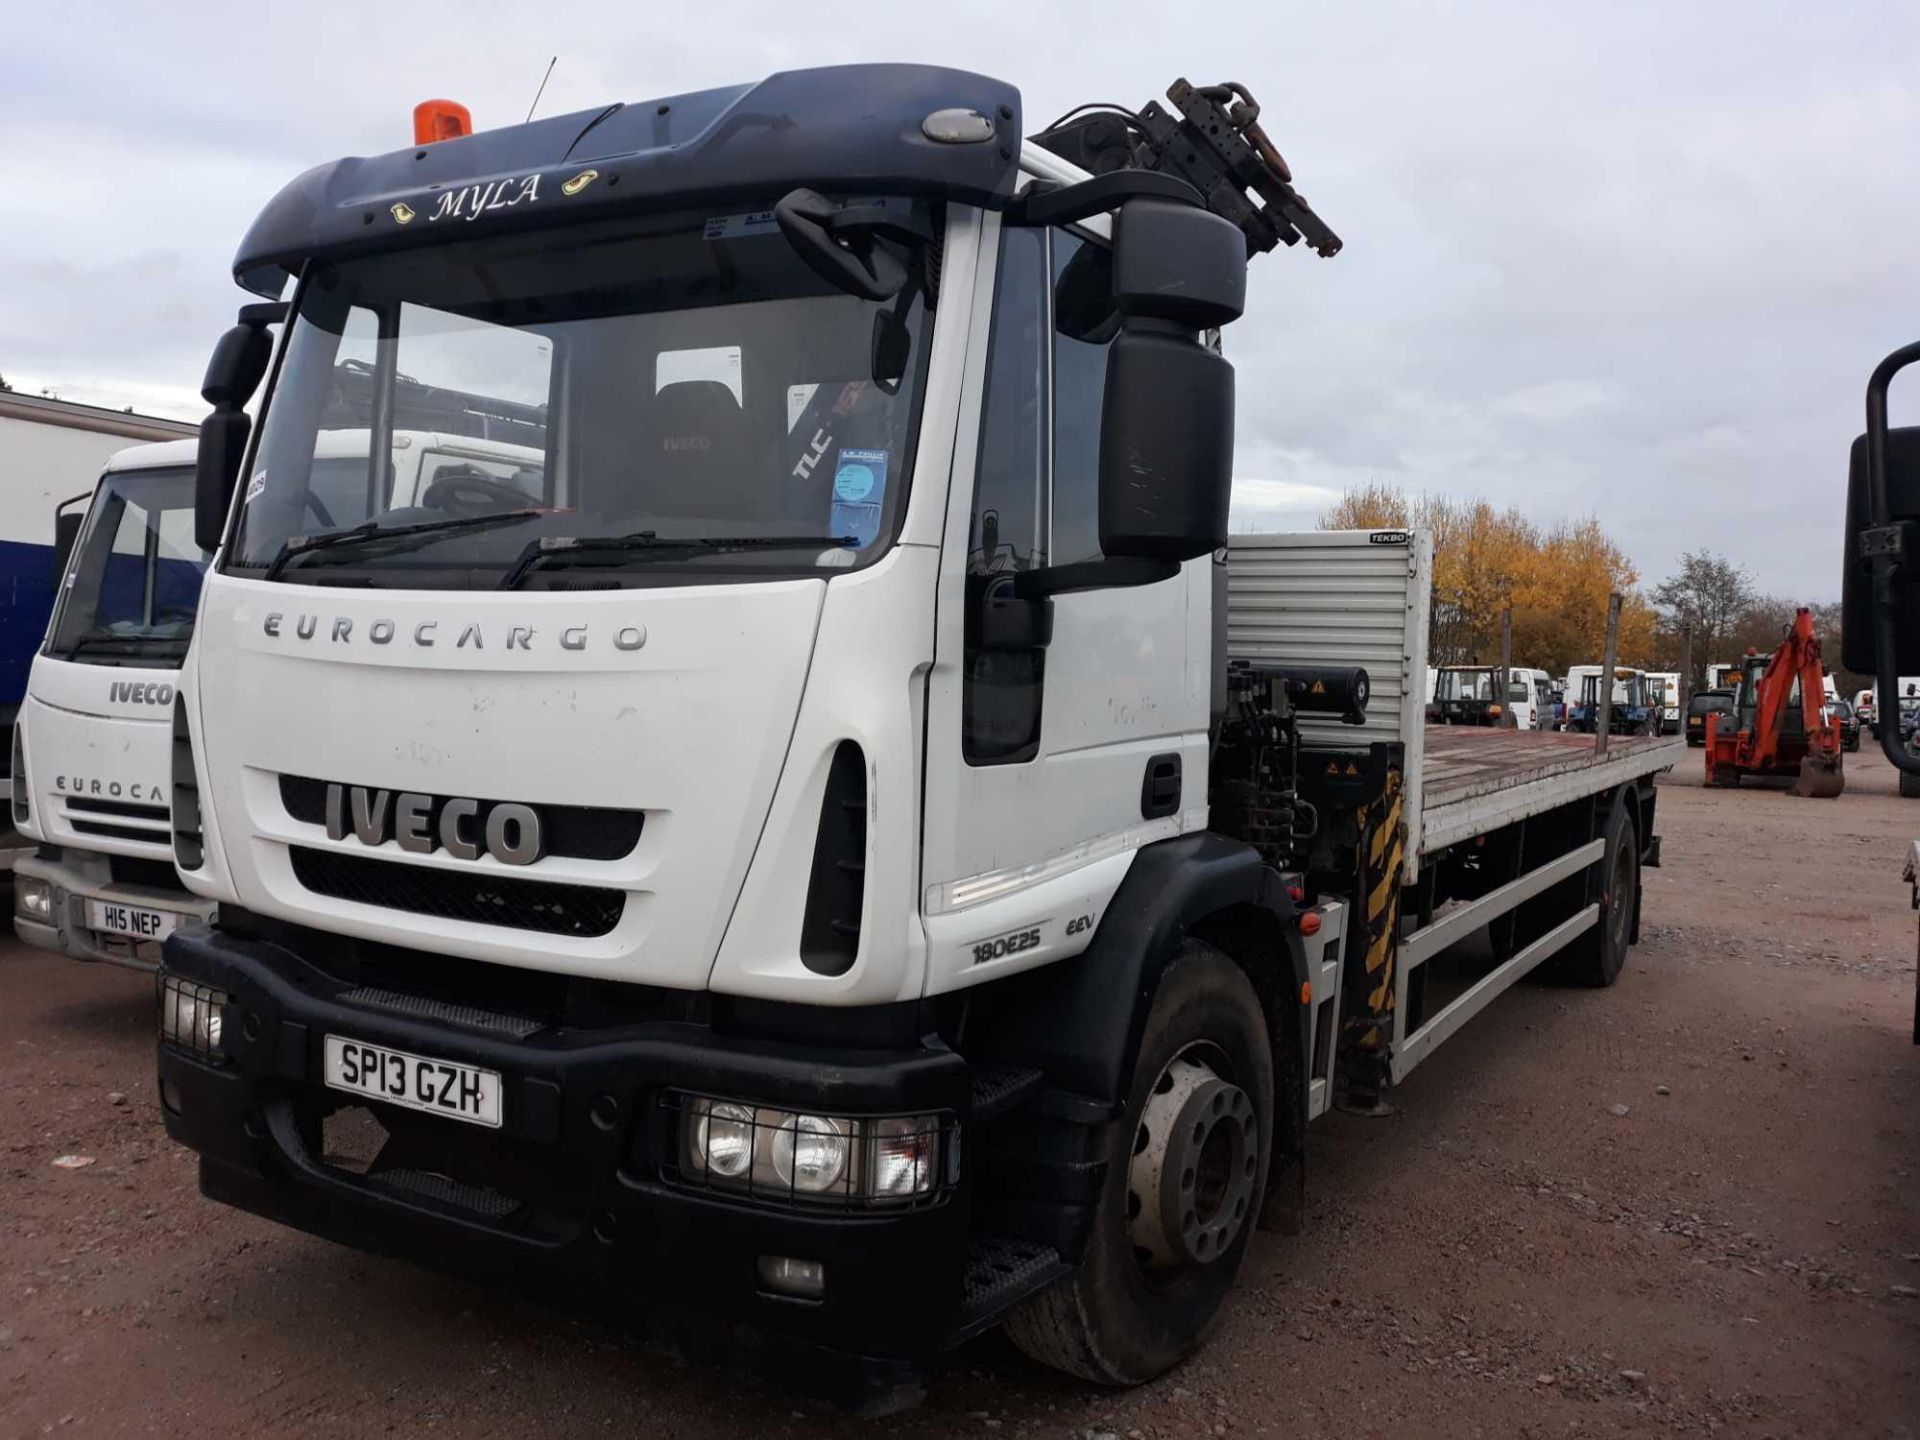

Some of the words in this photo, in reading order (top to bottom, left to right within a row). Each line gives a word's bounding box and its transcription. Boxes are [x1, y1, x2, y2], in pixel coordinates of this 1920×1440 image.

[428, 173, 541, 222] MYLA
[792, 428, 833, 480] TLC
[263, 612, 648, 651] EUROCARGO
[109, 681, 174, 706] IVECO
[56, 775, 163, 801] EUROCA
[325, 783, 541, 866] IVECO
[104, 905, 127, 931] H15
[130, 911, 161, 936] NEP
[972, 928, 1041, 965] 180E25
[1065, 913, 1096, 936] EEV
[342, 1043, 406, 1097] SP13
[416, 1061, 480, 1115] GZH
